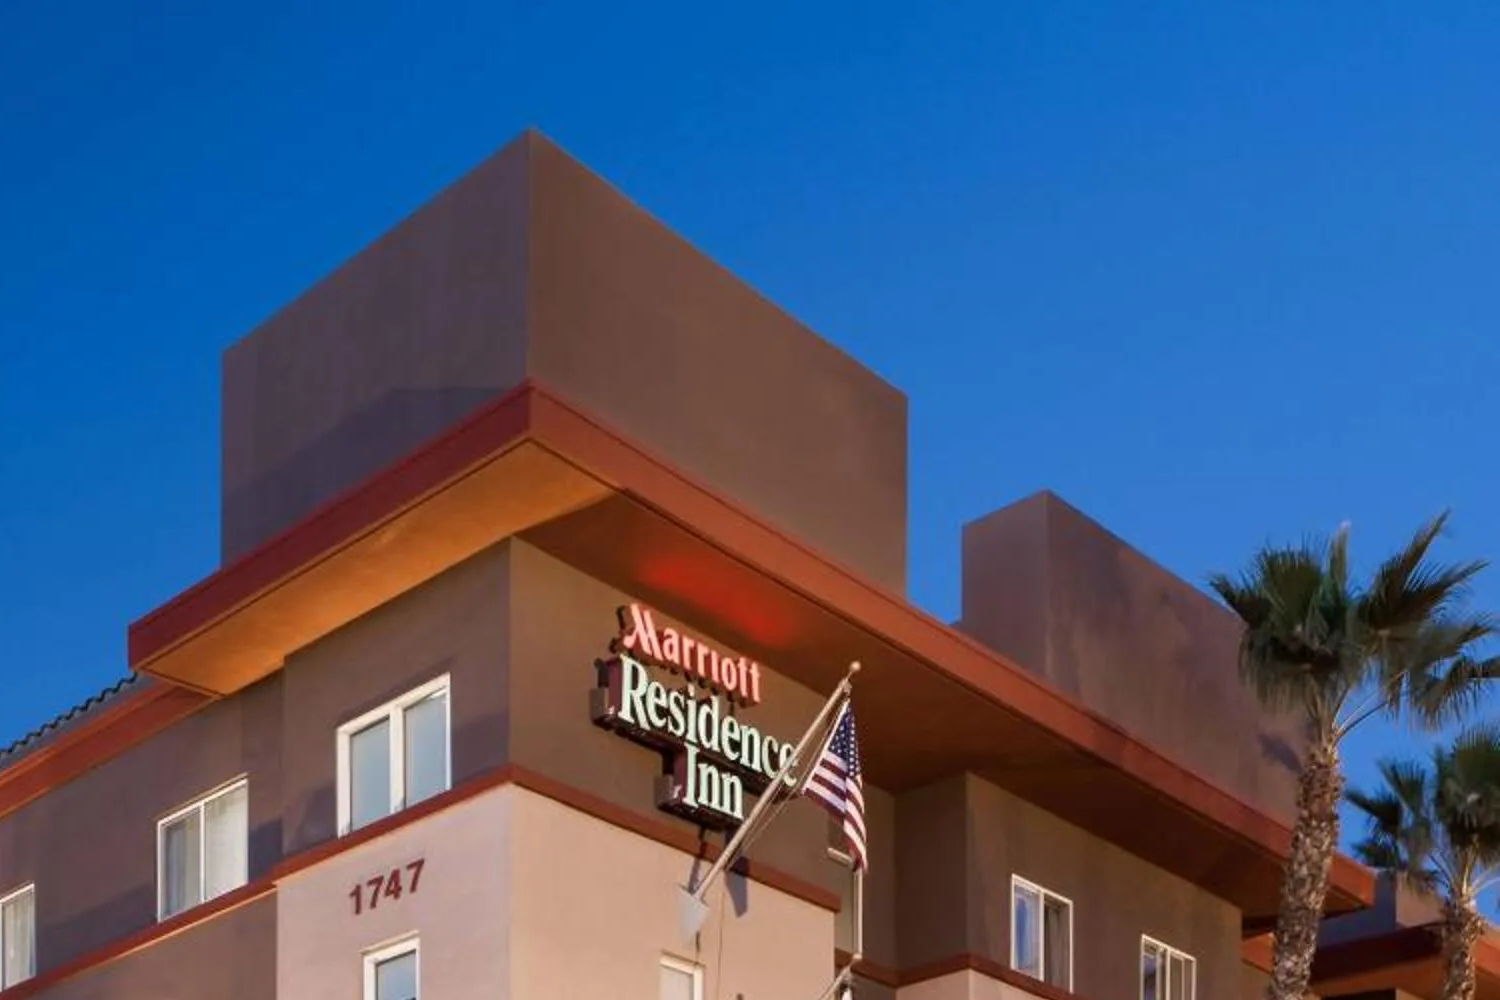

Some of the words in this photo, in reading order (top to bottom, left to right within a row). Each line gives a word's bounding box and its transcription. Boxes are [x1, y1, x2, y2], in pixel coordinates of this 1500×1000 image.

[622, 602, 762, 703] Marriott
[682, 742, 745, 820] Inn
[349, 858, 425, 915] 1747
